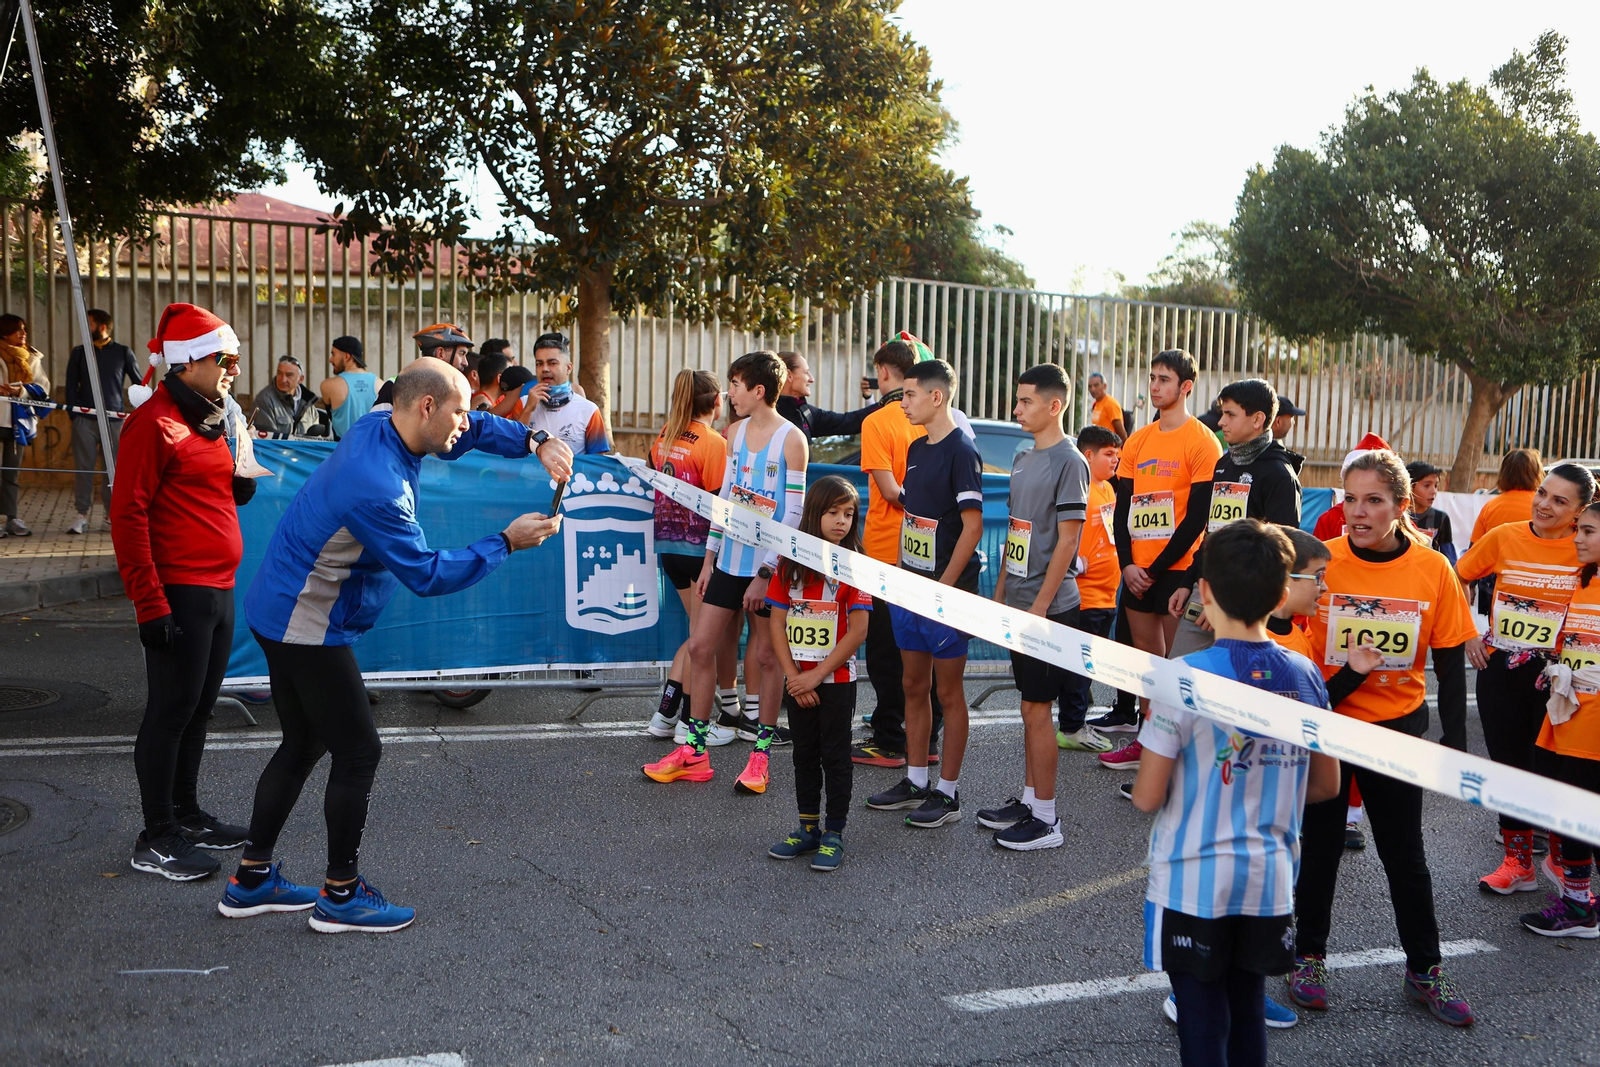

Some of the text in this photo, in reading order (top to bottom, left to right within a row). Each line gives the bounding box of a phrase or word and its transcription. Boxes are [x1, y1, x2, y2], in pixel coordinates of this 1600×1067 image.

[1134, 512, 1169, 528] 1041
[1210, 503, 1242, 520] 1030
[904, 535, 930, 558] 1021
[788, 625, 830, 646] 1033
[1501, 618, 1552, 643] 1073
